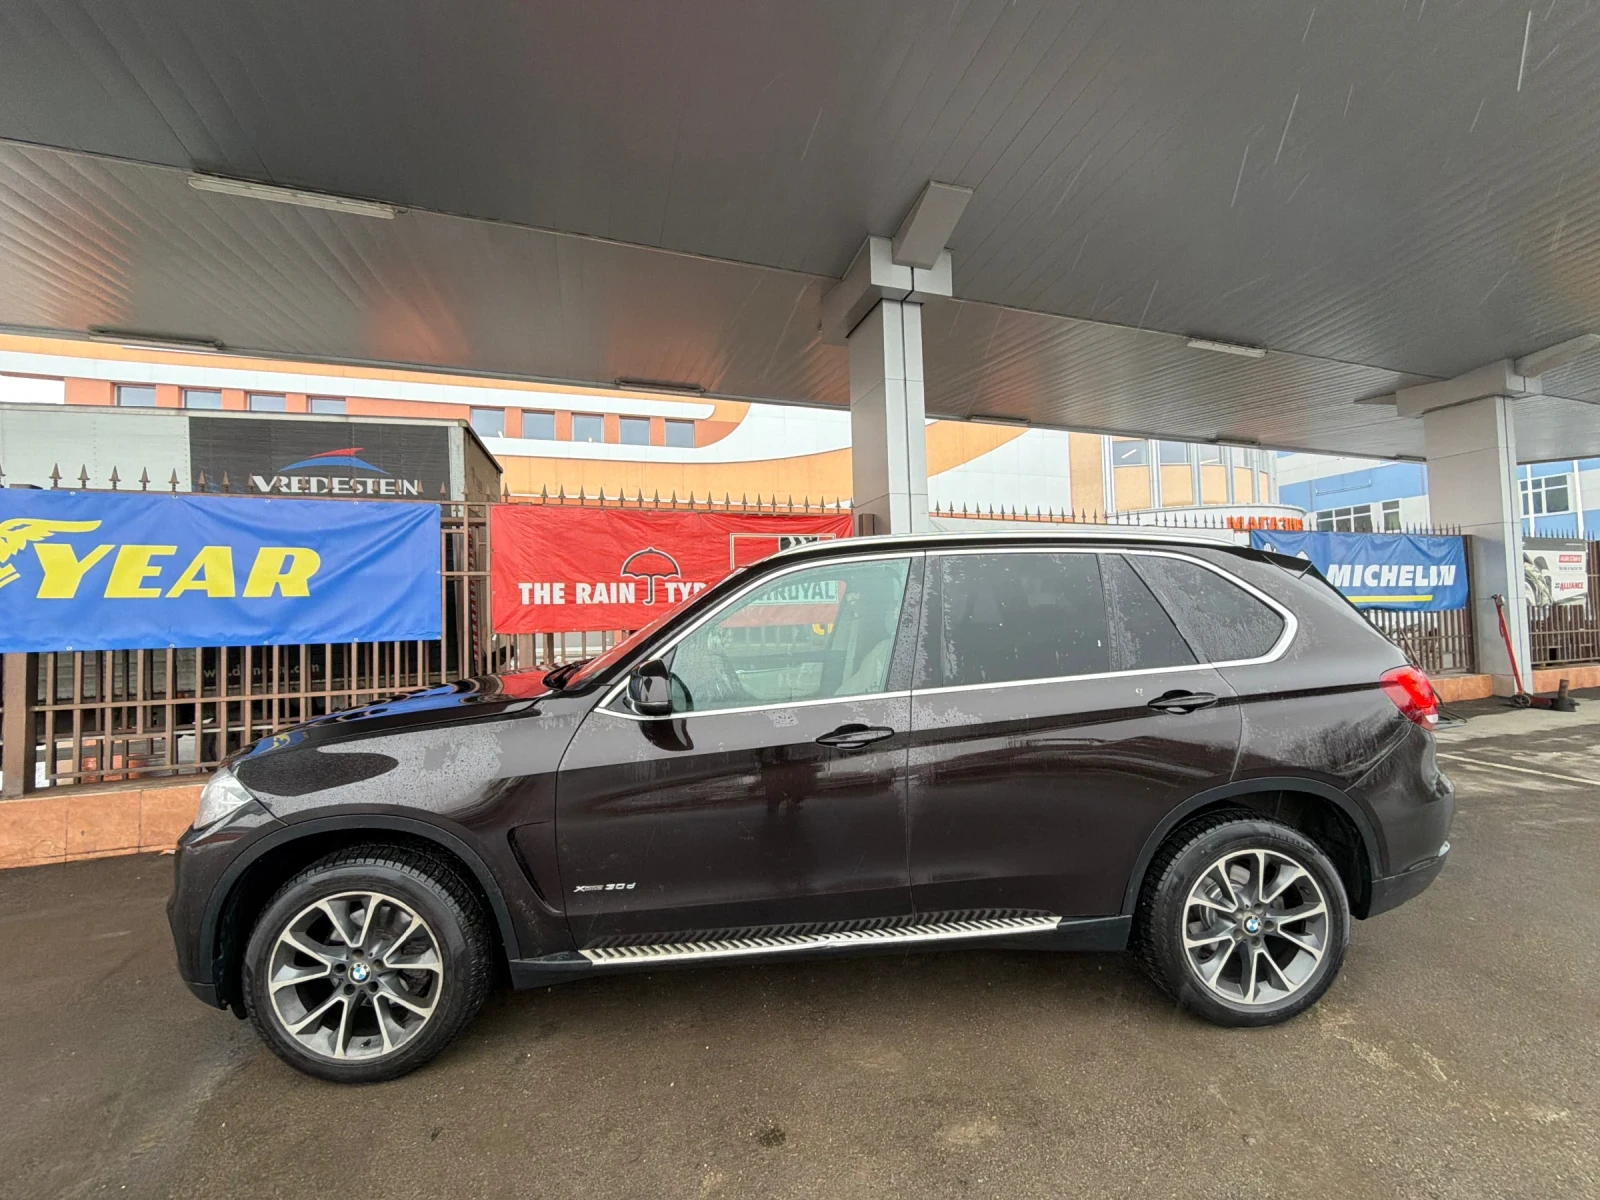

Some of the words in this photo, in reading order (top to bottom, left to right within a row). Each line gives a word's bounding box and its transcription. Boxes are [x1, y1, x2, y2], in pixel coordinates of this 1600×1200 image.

[252, 475, 419, 495] VREDESTEIN
[33, 543, 321, 599] YEAR
[1326, 564, 1456, 587] MICHELIN
[517, 582, 565, 605] THE
[575, 582, 635, 605] RAIN
[665, 582, 711, 603] TY
